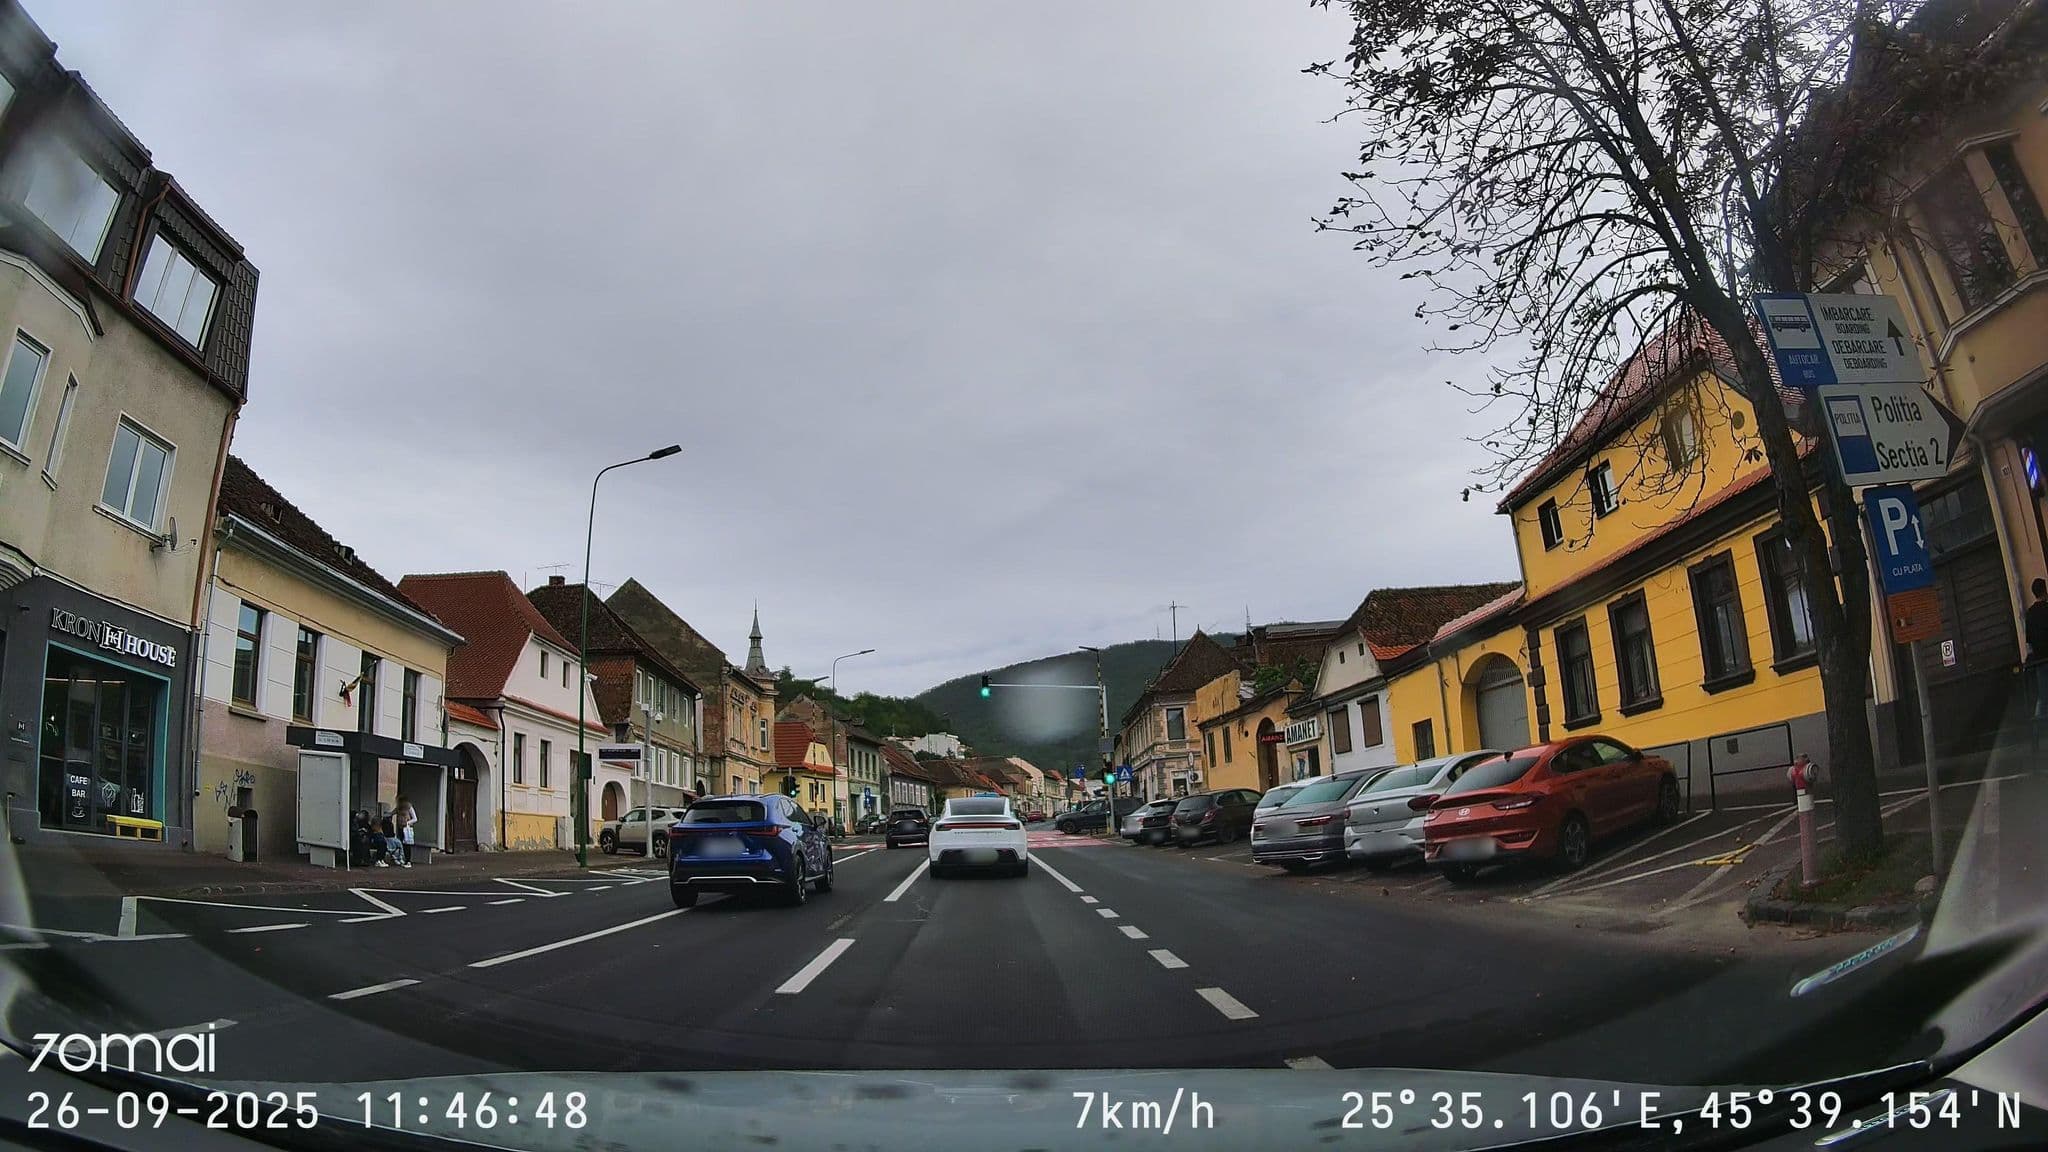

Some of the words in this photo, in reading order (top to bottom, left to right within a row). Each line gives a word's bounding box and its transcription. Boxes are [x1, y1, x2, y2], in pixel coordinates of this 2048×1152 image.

[1832, 340, 1887, 354] DEBARCARE
[1930, 437, 1944, 465] 2
[1879, 497, 1908, 556] P
[1892, 566, 1903, 577] CU
[1903, 563, 1924, 574] PLATA
[51, 607, 101, 642] KRON
[124, 634, 177, 667] HOUSE
[1286, 720, 1317, 745] AMANET
[70, 775, 88, 785] CAFE
[71, 788, 86, 798] BAR
